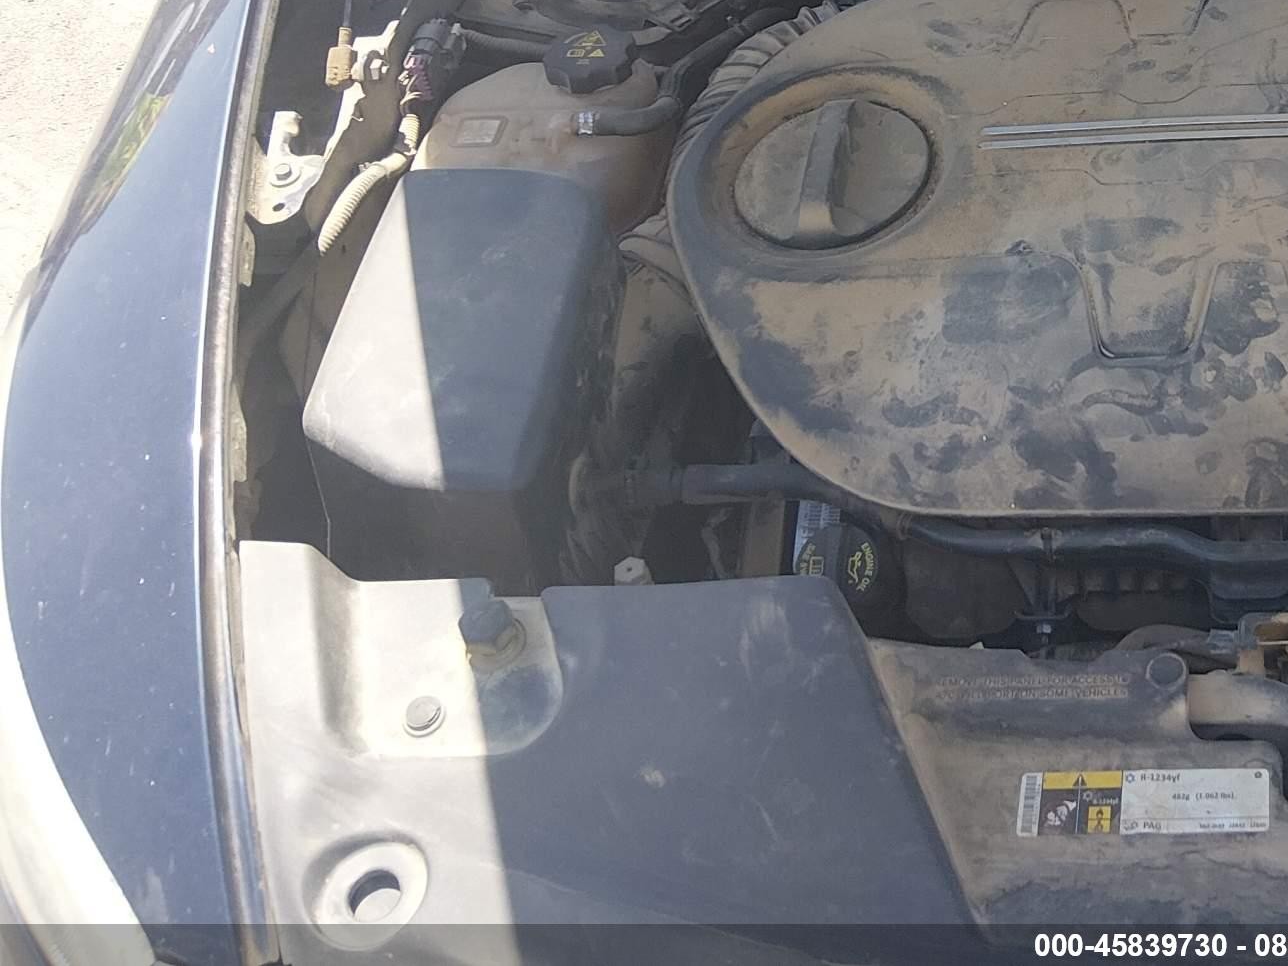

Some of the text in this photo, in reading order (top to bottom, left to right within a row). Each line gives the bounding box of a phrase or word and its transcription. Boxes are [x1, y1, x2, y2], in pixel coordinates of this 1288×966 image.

[856, 542, 875, 592] ENGINE OIL
[1070, 674, 1113, 685] ACCESS
[1040, 688, 1071, 699] SOME
[1074, 688, 1129, 699] VEHICLES
[1140, 773, 1181, 783] R-1234yf
[1143, 821, 1162, 830] PAG
